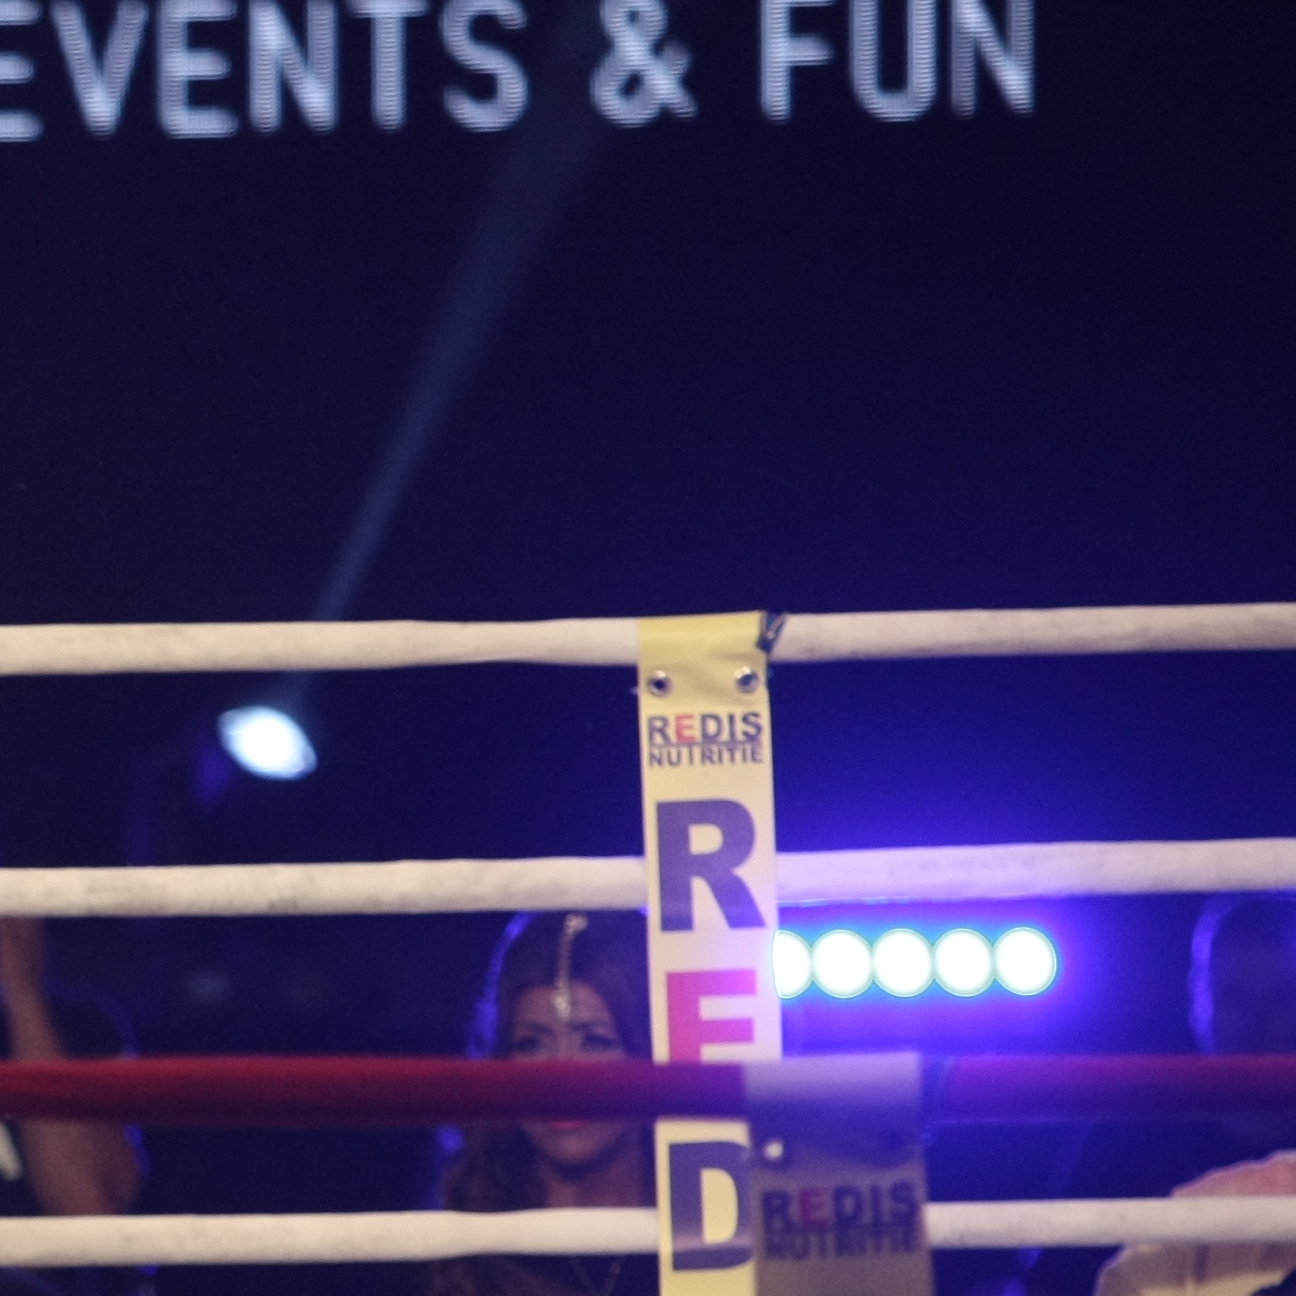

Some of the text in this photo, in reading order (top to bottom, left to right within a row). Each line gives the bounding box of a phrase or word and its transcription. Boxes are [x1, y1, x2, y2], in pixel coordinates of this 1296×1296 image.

[590, 0, 698, 127] &
[760, 0, 1037, 121] FUN
[647, 711, 764, 745] REDIS
[648, 742, 765, 769] NUTRITIE
